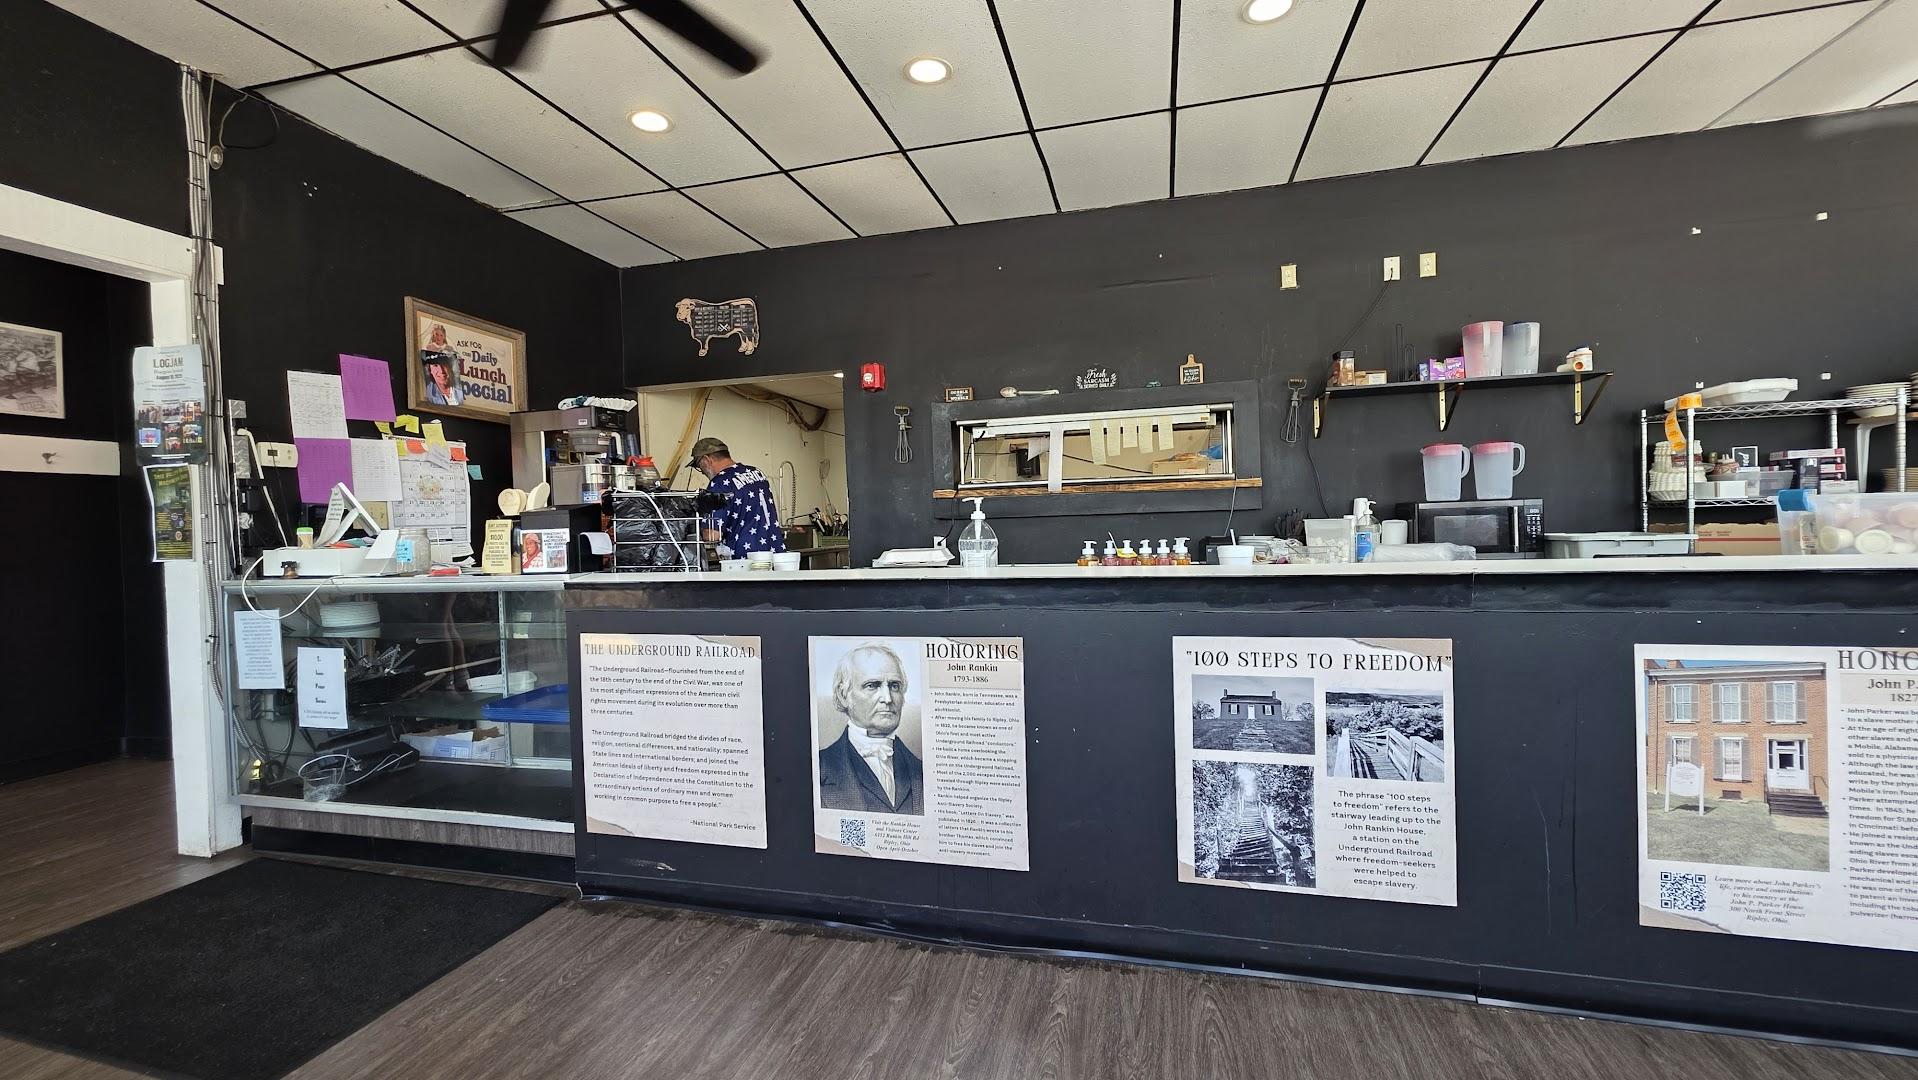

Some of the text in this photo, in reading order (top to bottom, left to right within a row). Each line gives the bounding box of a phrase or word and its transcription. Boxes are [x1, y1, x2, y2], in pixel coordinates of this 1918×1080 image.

[470, 342, 482, 350] FOR
[472, 351, 497, 366] Daily
[458, 359, 507, 385] Lunch
[461, 381, 513, 404] pecial
[585, 644, 756, 658] THE UNDERGROUND RAILROAD
[926, 644, 1018, 659] HONORING
[1186, 650, 1452, 672] "100 STEPS TO FREEDOM"
[1867, 679, 1901, 689] John
[603, 730, 639, 738] Underground
[665, 733, 686, 741] bridged
[1848, 760, 1883, 770] Although
[1339, 790, 1353, 798] The
[1356, 791, 1384, 801] phrase
[1407, 794, 1431, 804] steps
[1334, 800, 1342, 808] to
[1385, 803, 1410, 812] refers
[1424, 806, 1439, 814] the
[1331, 811, 1366, 822] stairway
[1369, 813, 1400, 824] leading
[1416, 816, 1424, 824] to
[1344, 823, 1426, 836] John Rankin House,
[1360, 835, 1389, 843] station
[1405, 837, 1419, 845] the
[1339, 844, 1432, 856] Underground Railroad
[1336, 854, 1436, 868] where freedom-seekers
[1377, 868, 1405, 878] helped
[1354, 879, 1417, 890] escape slavery.
